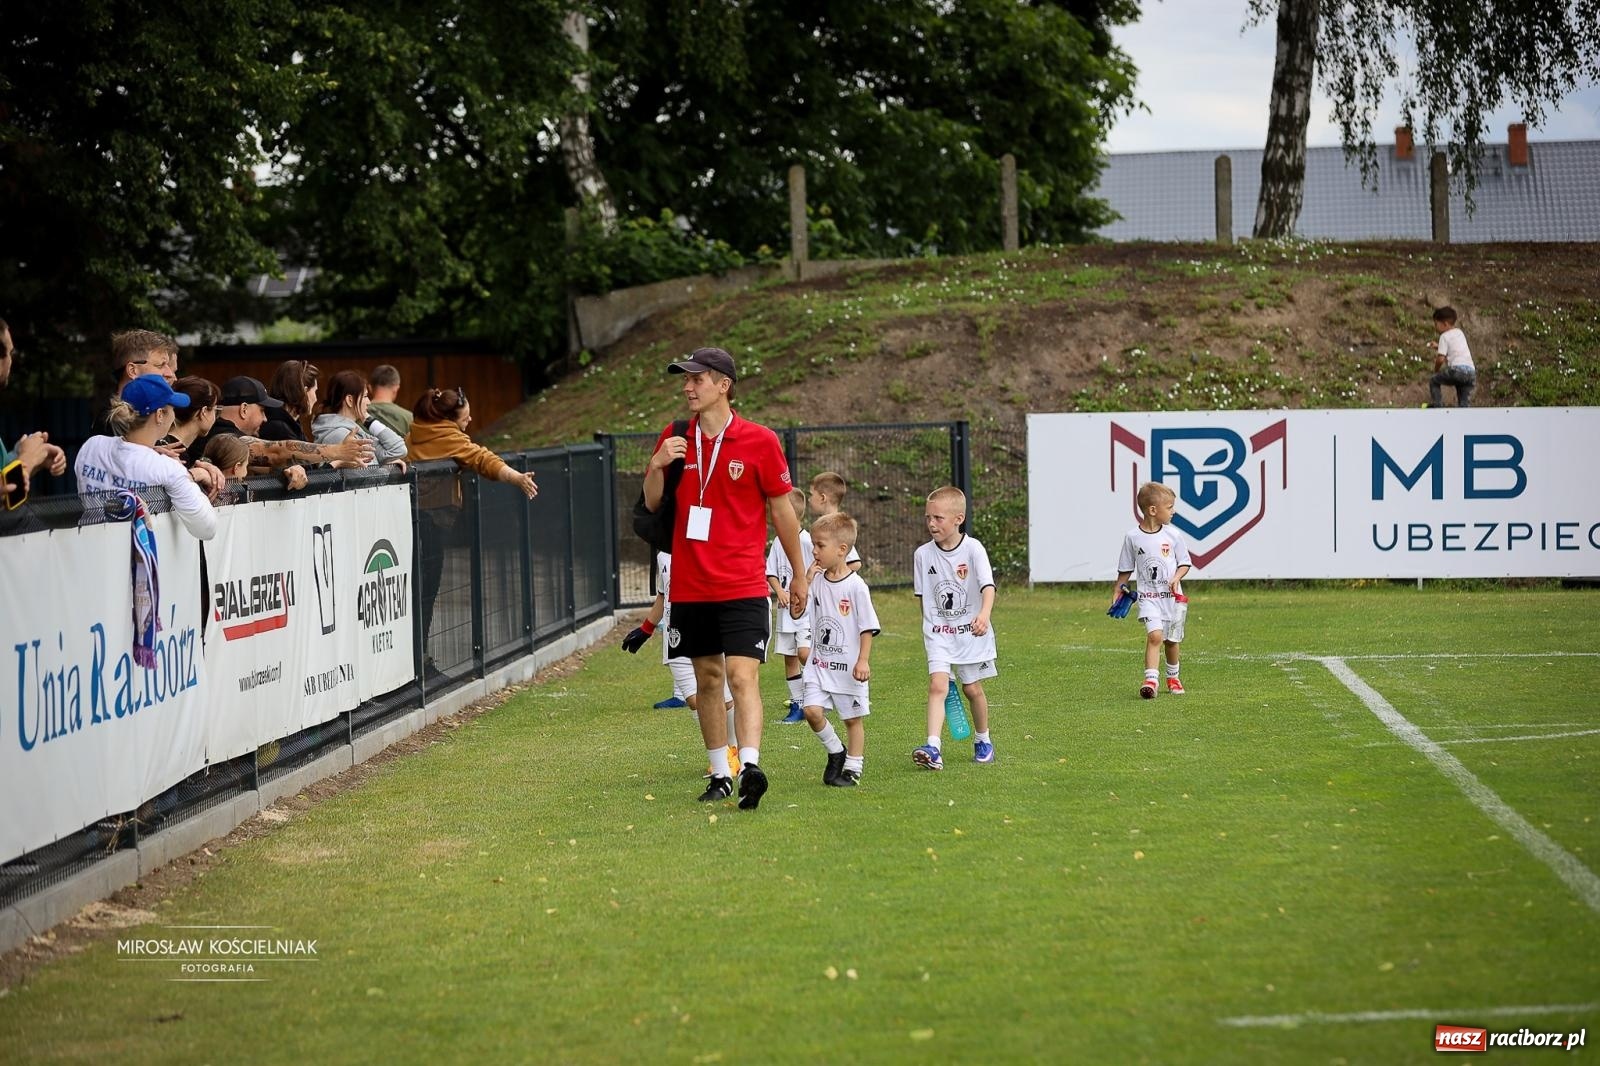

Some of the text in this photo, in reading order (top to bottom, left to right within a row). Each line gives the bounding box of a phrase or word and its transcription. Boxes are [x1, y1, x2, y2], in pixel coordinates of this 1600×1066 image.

[82, 464, 106, 482] FAN
[1371, 433, 1528, 500] MB
[15, 603, 198, 751] Unia Raibórz
